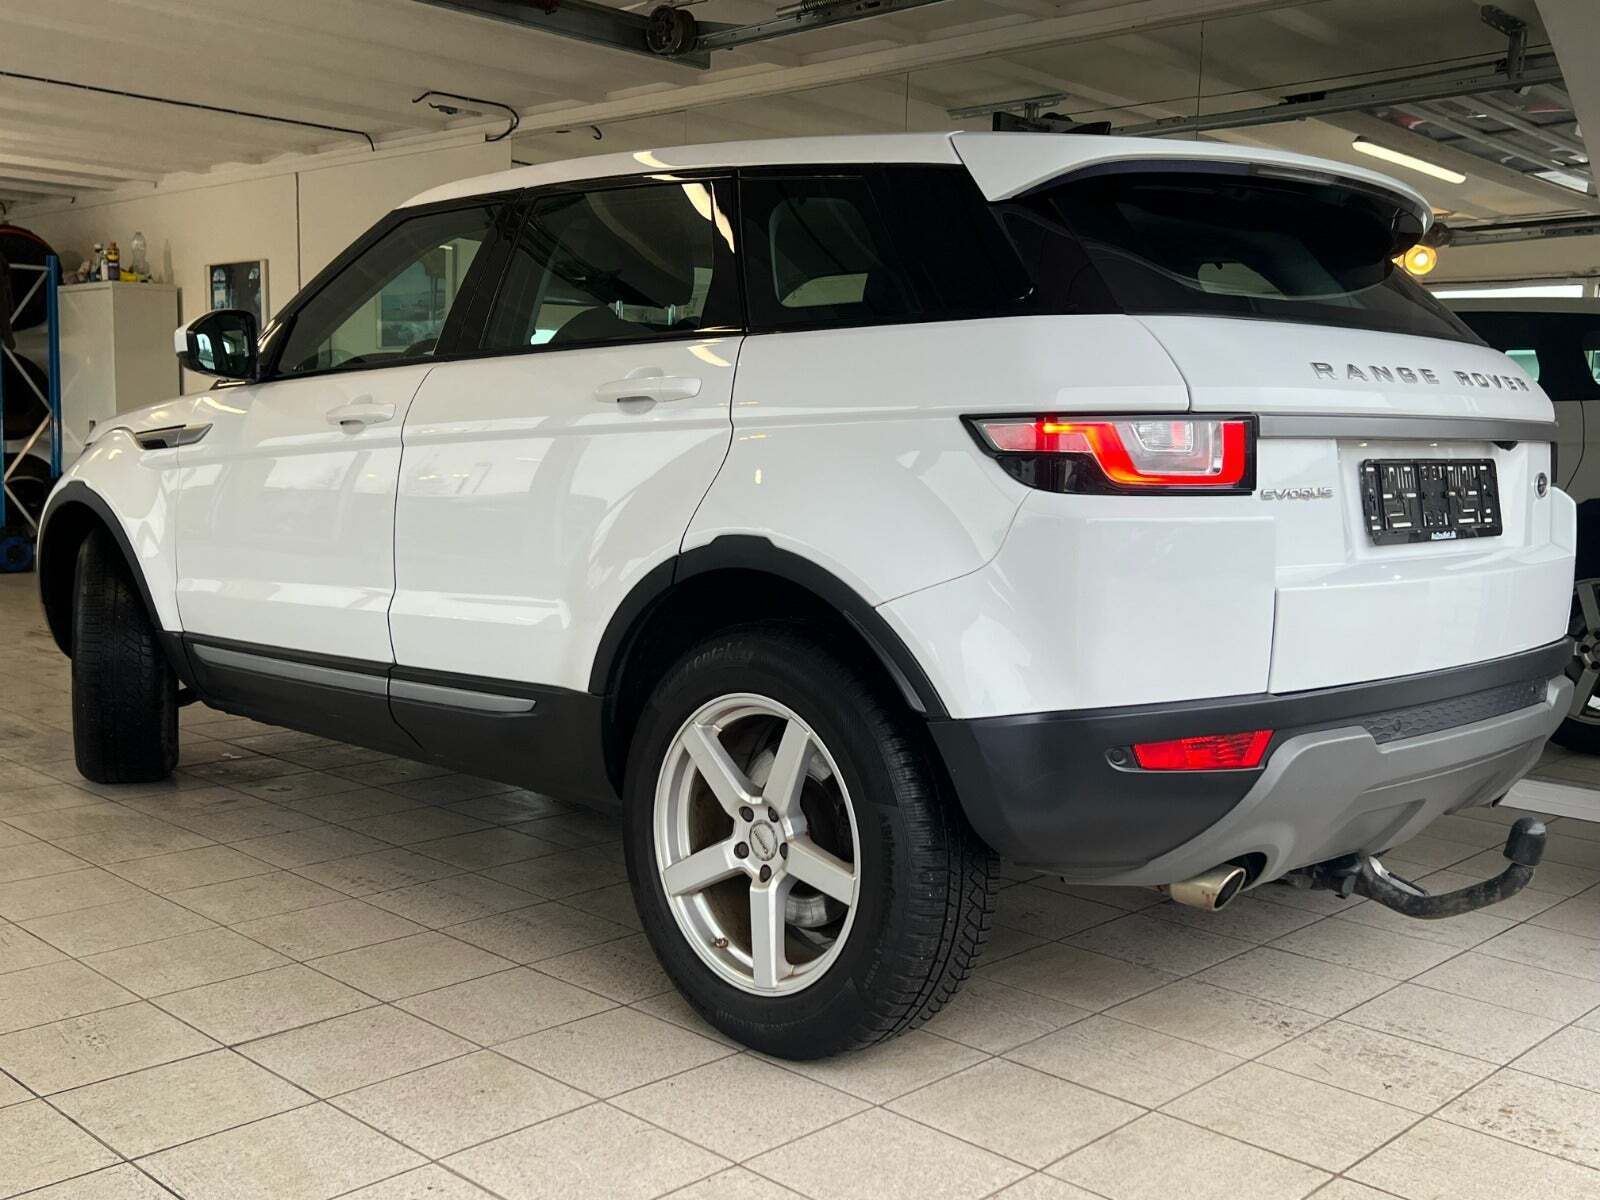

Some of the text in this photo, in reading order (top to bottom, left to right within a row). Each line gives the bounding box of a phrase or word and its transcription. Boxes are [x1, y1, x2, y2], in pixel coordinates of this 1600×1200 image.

[1310, 362, 1530, 392] RANGE ROVER
[1260, 487, 1335, 501] EVOQUE
